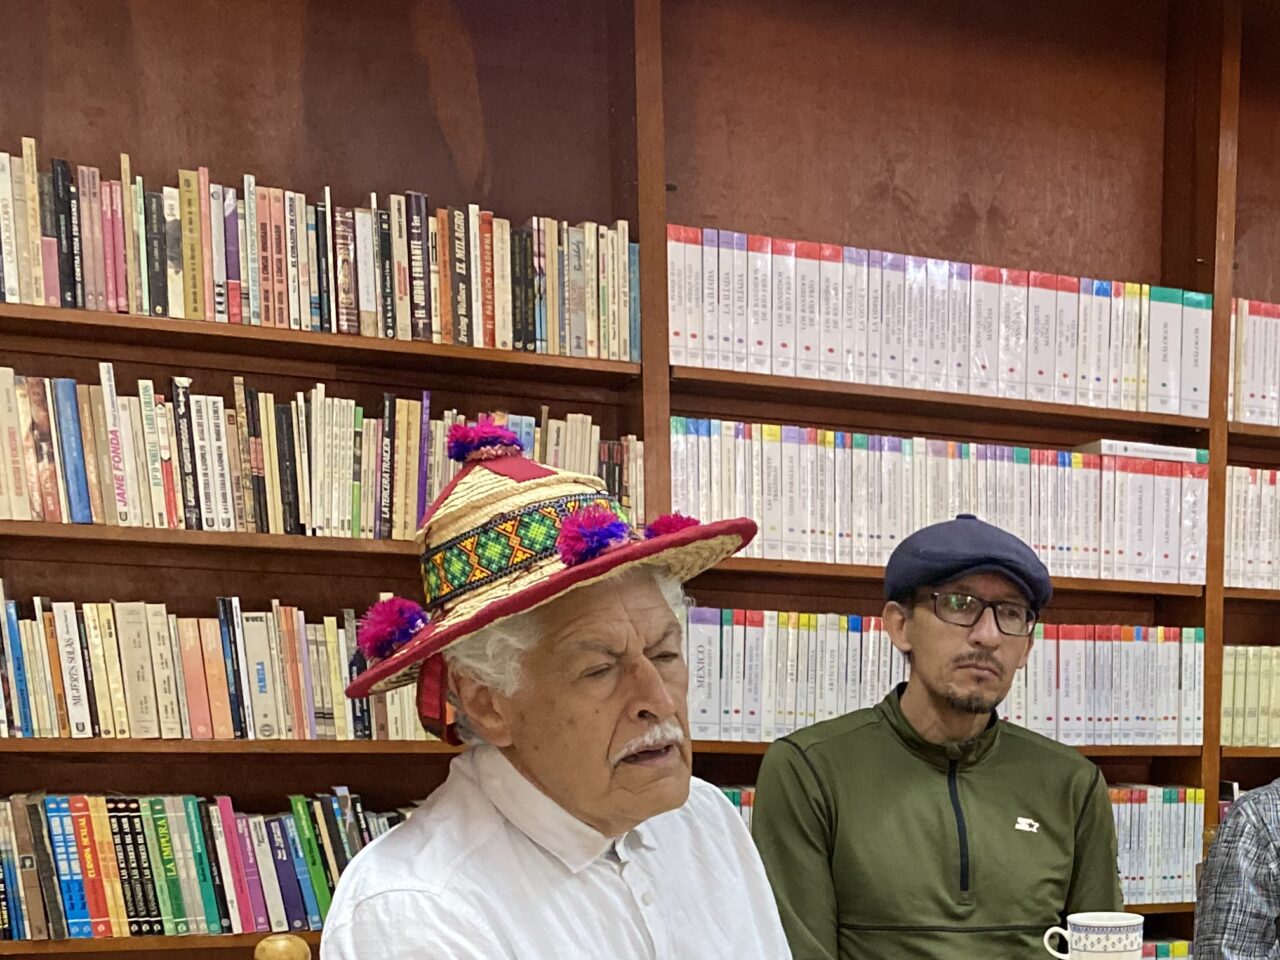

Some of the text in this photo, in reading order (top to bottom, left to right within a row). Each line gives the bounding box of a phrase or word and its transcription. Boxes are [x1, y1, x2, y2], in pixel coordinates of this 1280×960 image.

[71, 199, 80, 236] ESPERANZA
[73, 237, 81, 254] TODA
[454, 210, 467, 276] EL MILAGRO
[74, 255, 82, 282] CONTRA
[410, 240, 426, 318] EL JUDIO ERRANTE
[484, 277, 494, 316] PALACIO
[707, 301, 715, 313] LA
[457, 282, 469, 343] Irving Wallace
[723, 303, 731, 314] LA
[737, 305, 744, 316] LA
[485, 320, 494, 329] EL
[141, 385, 157, 434] LARRY COLLINS
[382, 437, 391, 473] TRAICION
[110, 429, 128, 507] JANE FONDA
[381, 473, 390, 507] TERCERA
[381, 507, 390, 519] LA
[64, 637, 76, 664] SOLAS
[694, 644, 706, 689] MÉXICO
[67, 665, 83, 707] MUJERES
[110, 817, 119, 833] AMOR
[121, 817, 130, 833] AMOR
[133, 817, 142, 833] AMOR
[79, 816, 96, 878] EUROPA SEXUAL
[112, 833, 121, 844] DEL
[124, 833, 133, 844] DEL
[136, 833, 145, 844] DEL
[156, 819, 177, 876] LA IMPURA
[120, 869, 129, 880] LAS
[131, 868, 140, 879] LAS
[143, 868, 152, 879] LAS
